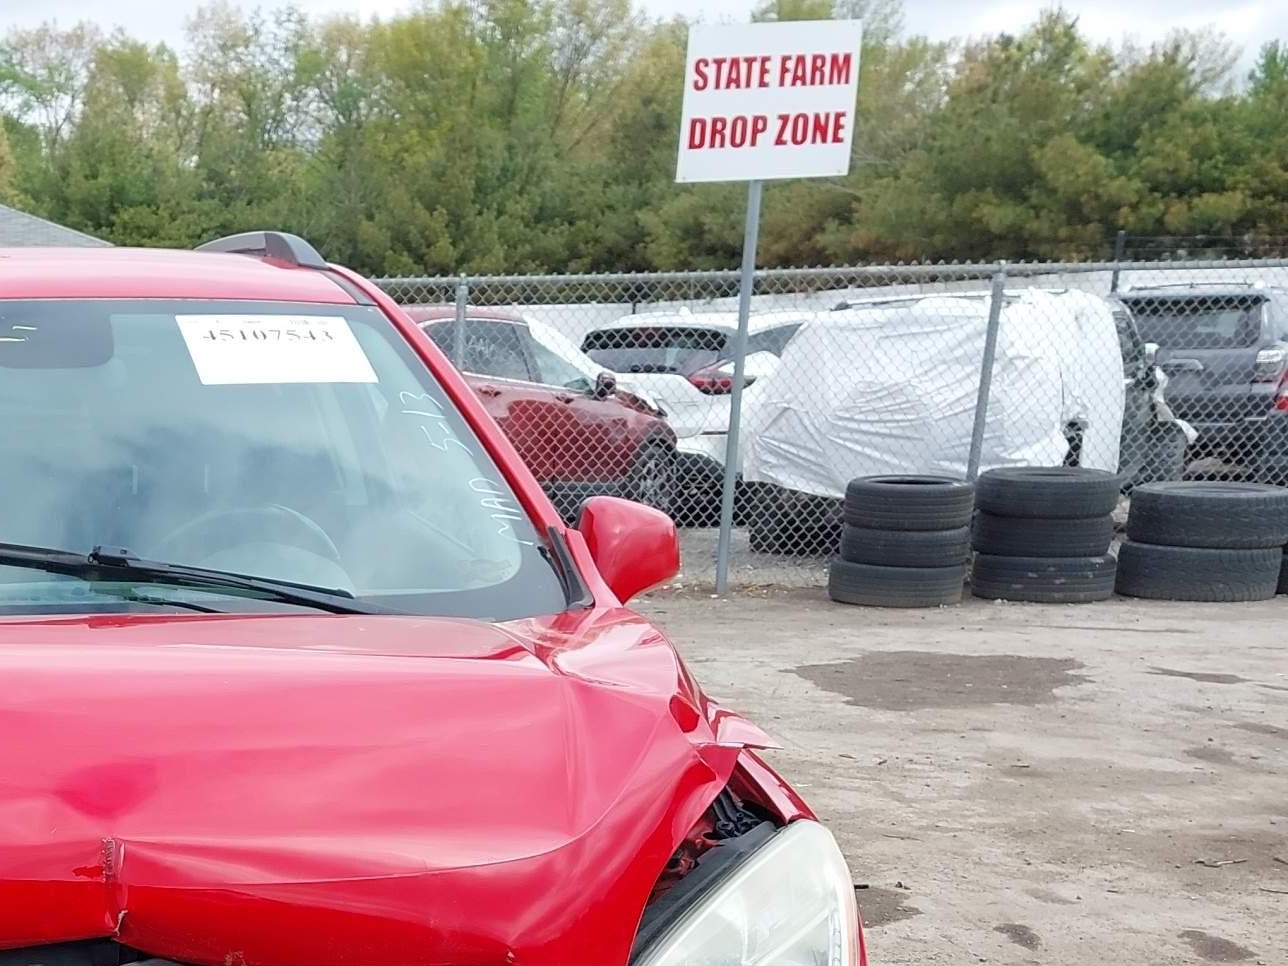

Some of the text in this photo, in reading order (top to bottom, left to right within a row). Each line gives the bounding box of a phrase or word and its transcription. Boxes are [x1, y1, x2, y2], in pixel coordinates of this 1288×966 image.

[693, 53, 852, 91] STATE FARM
[688, 111, 847, 150] DROP ZONE
